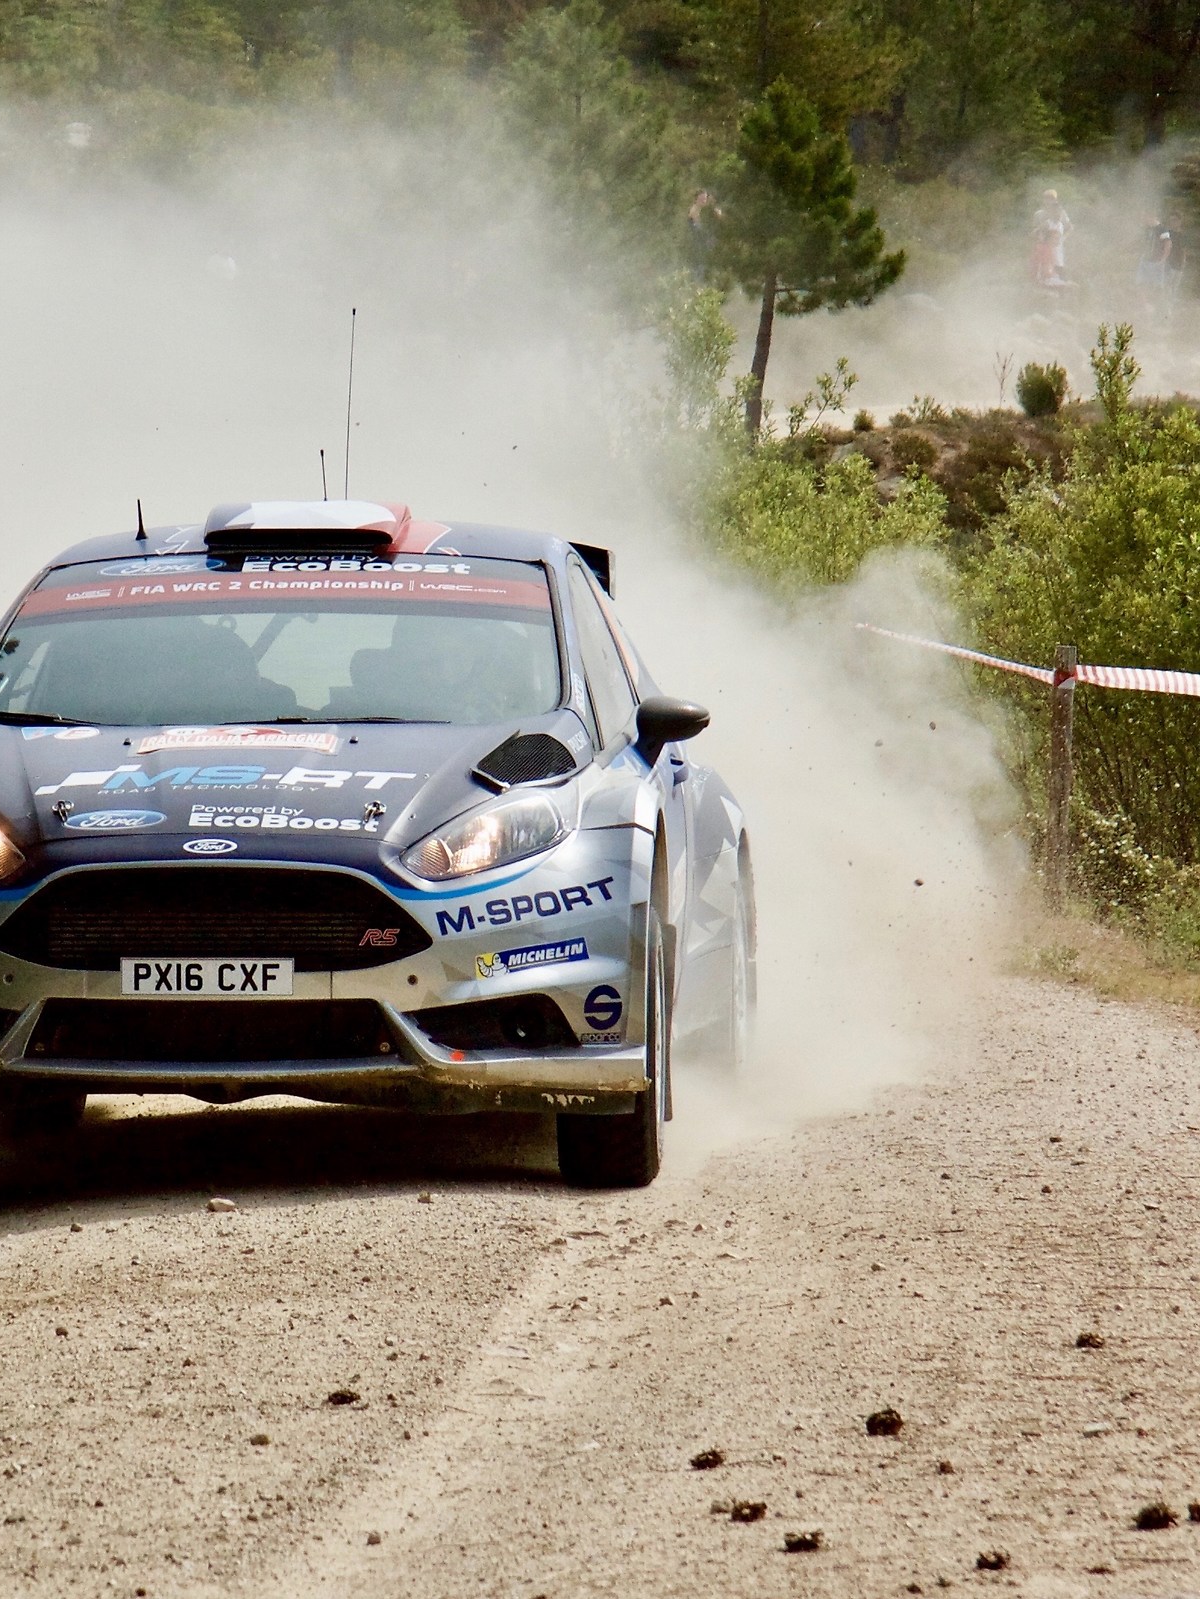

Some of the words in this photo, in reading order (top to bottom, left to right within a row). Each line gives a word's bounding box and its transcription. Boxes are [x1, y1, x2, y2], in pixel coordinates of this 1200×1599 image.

[241, 560, 471, 575] EcoBoost
[130, 584, 165, 596] FIA
[173, 580, 222, 593] WRC
[228, 581, 242, 591] 2
[249, 579, 404, 592] Championship
[147, 735, 192, 746] RALLY
[194, 734, 243, 745] ITALIA
[246, 733, 326, 745] SARDEGNA
[102, 765, 417, 790] MS-RT
[97, 786, 156, 795] ROAD
[171, 783, 320, 793] TECHNOLOGY
[191, 804, 277, 815] Powered
[281, 806, 304, 818] by
[187, 813, 380, 833] EcoBoost
[435, 876, 615, 936] M-SPORT
[358, 928, 400, 946] RS
[507, 942, 585, 967] MICHELIN
[133, 963, 204, 991] PX16
[218, 963, 280, 991] CXF
